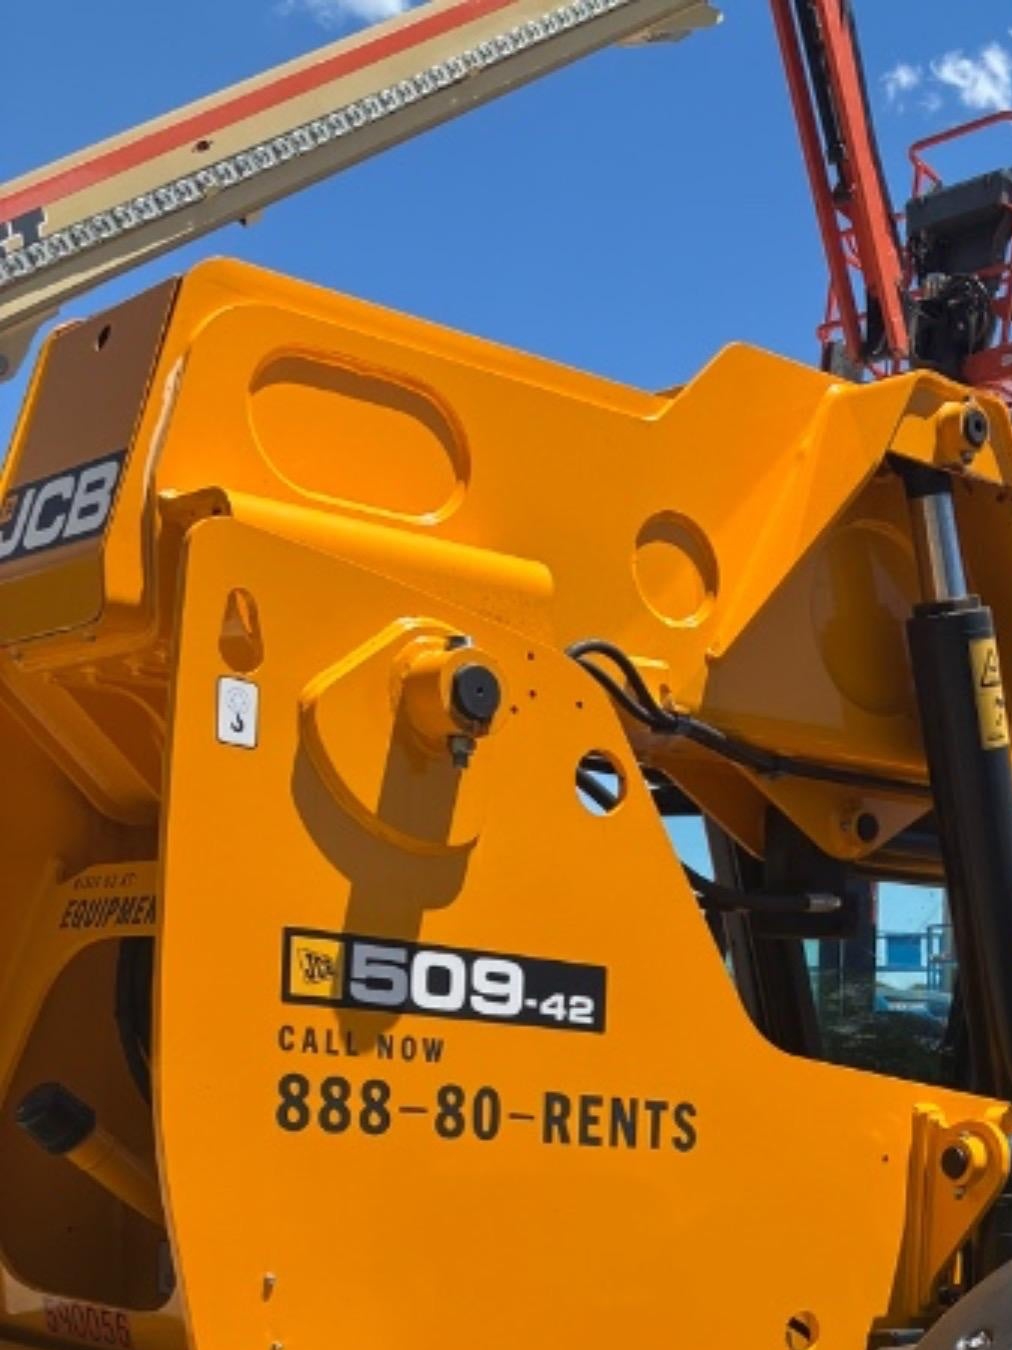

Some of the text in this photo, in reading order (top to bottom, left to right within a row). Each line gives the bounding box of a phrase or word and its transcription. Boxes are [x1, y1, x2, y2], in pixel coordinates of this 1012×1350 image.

[0, 460, 120, 559] JCB
[349, 942, 596, 1025] 509-42
[278, 1025, 446, 1063] CALL NOW
[275, 1072, 699, 1153] 888-80-RENTS
